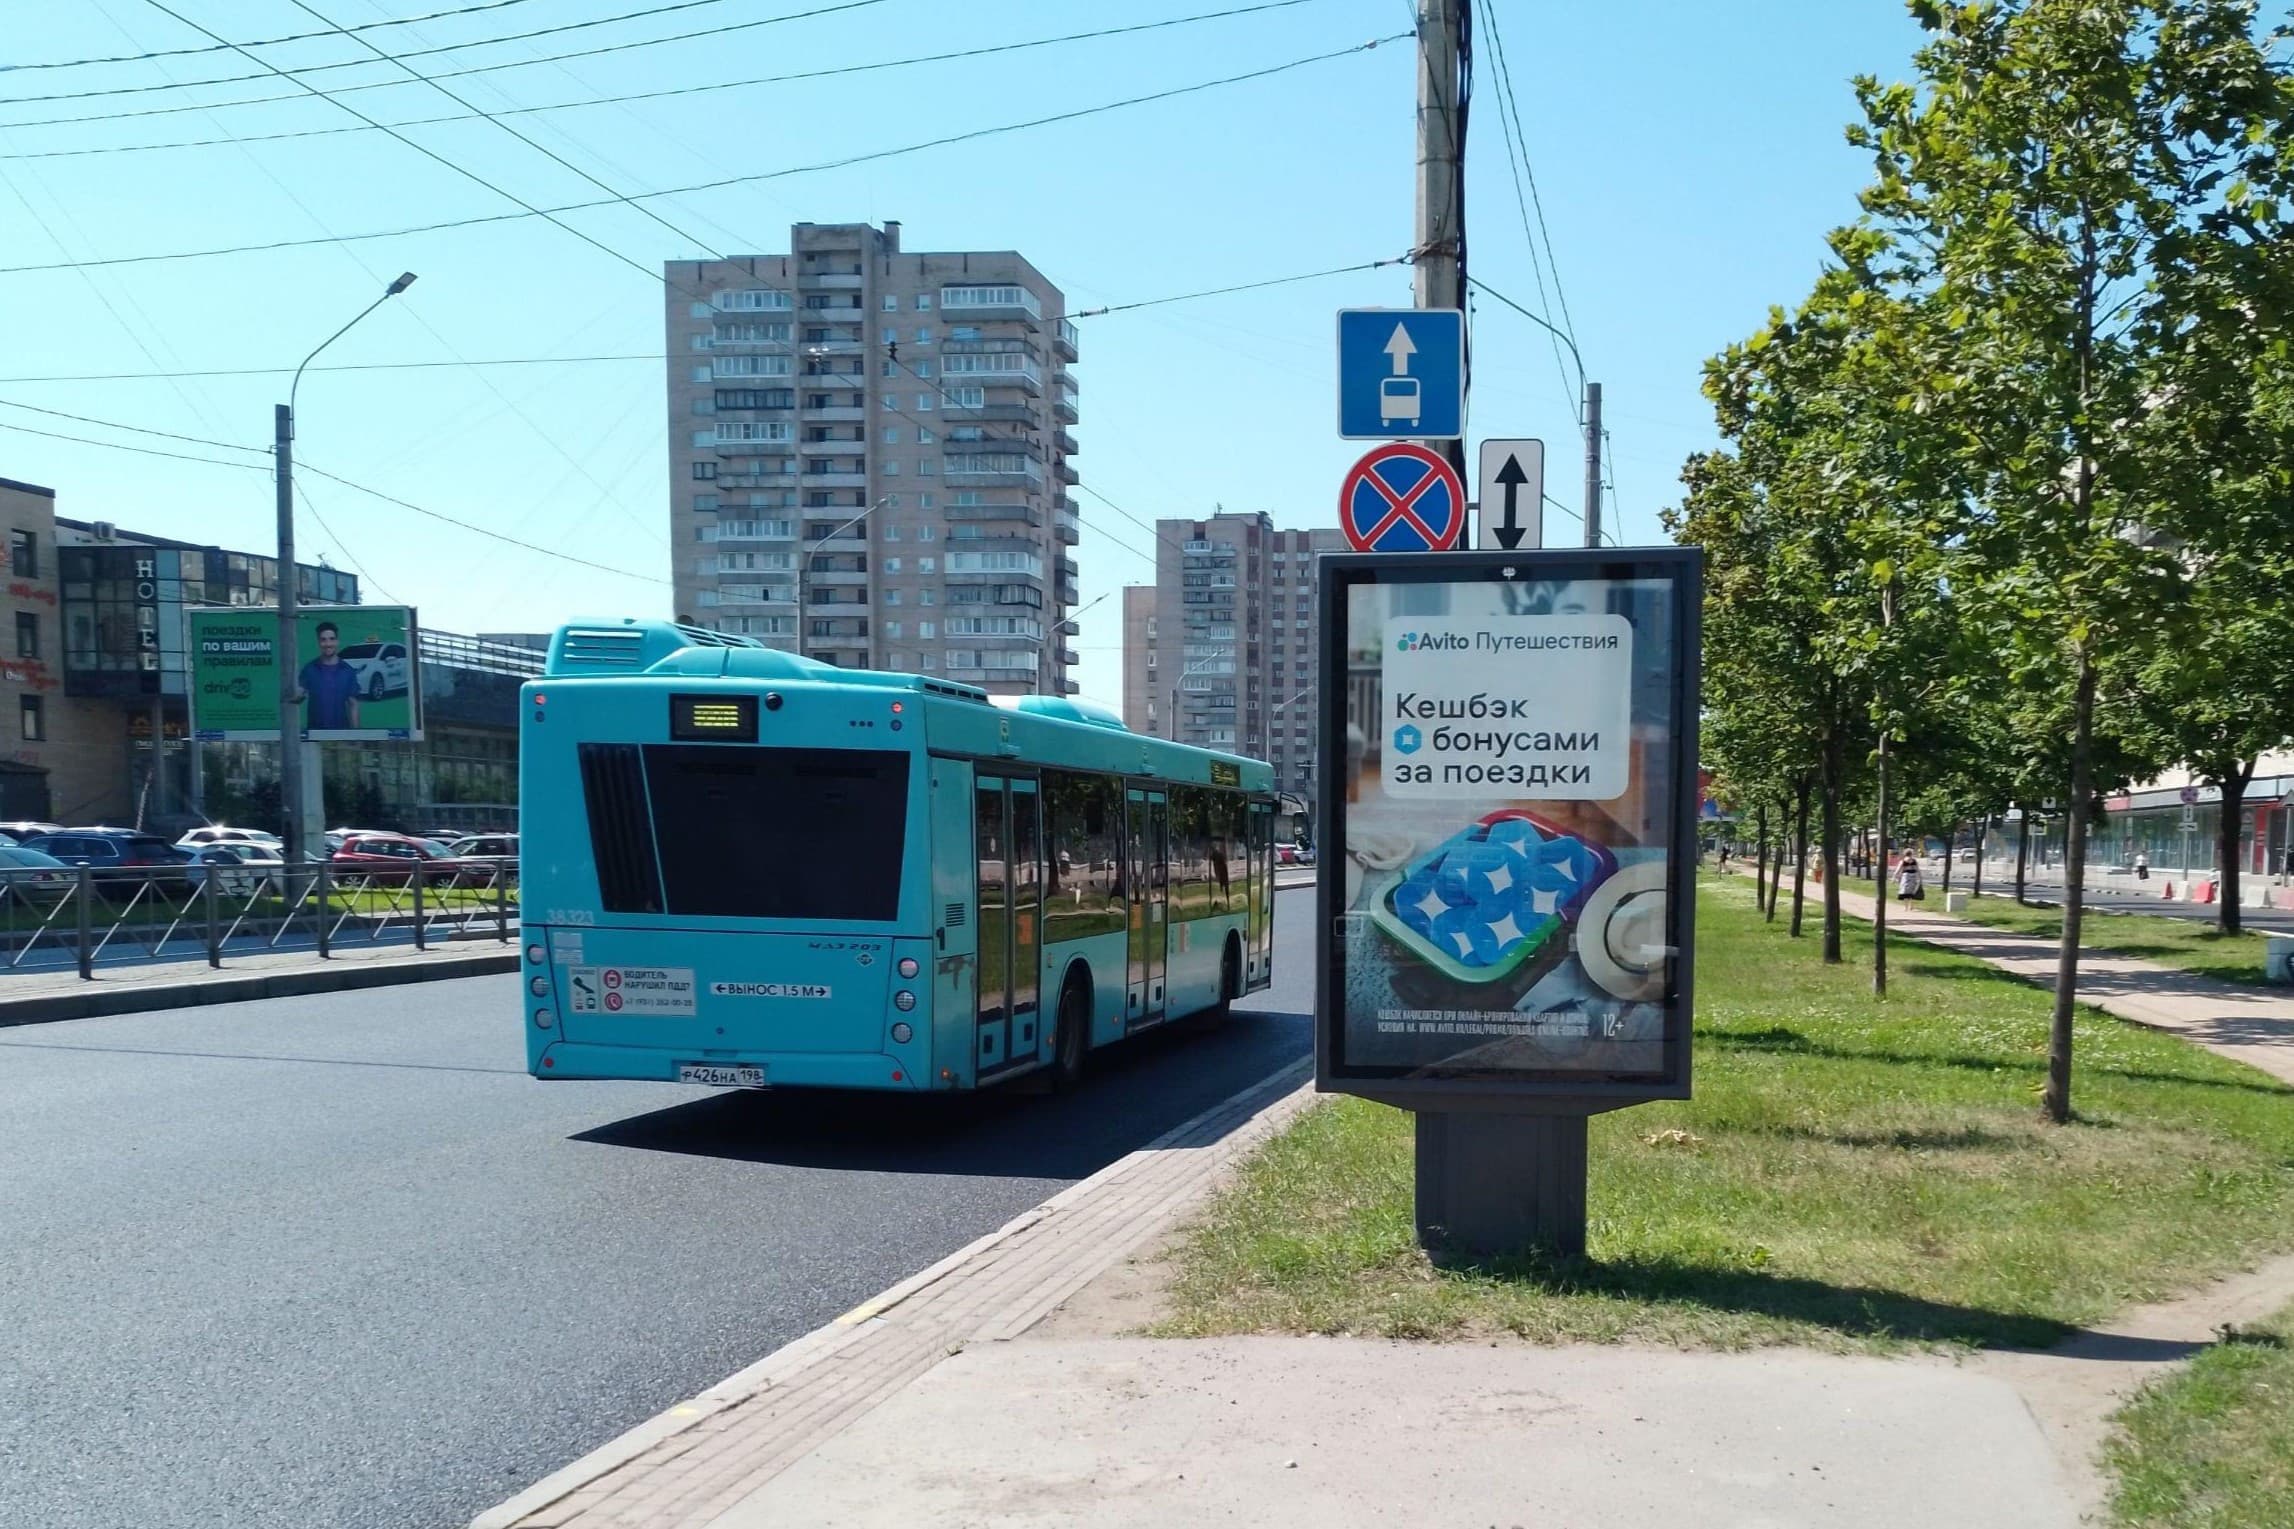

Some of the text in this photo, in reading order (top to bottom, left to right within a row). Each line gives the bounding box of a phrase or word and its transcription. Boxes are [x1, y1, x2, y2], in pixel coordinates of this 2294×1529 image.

[136, 560, 158, 670] HOTEL
[202, 641, 272, 652] по вашим
[1418, 632, 1618, 653] Avito Путешествия
[1396, 693, 1529, 719] Кешбэк
[1432, 725, 1600, 758] бонусами
[1394, 764, 1590, 788] за поездки
[848, 943, 882, 951] 203
[624, 970, 668, 979] ВОДИТЕЛЬ
[624, 981, 666, 990] НАРУШИЛ
[728, 983, 777, 996] ВЫНОС
[802, 986, 814, 997] М
[1602, 1013, 1624, 1037] 12+
